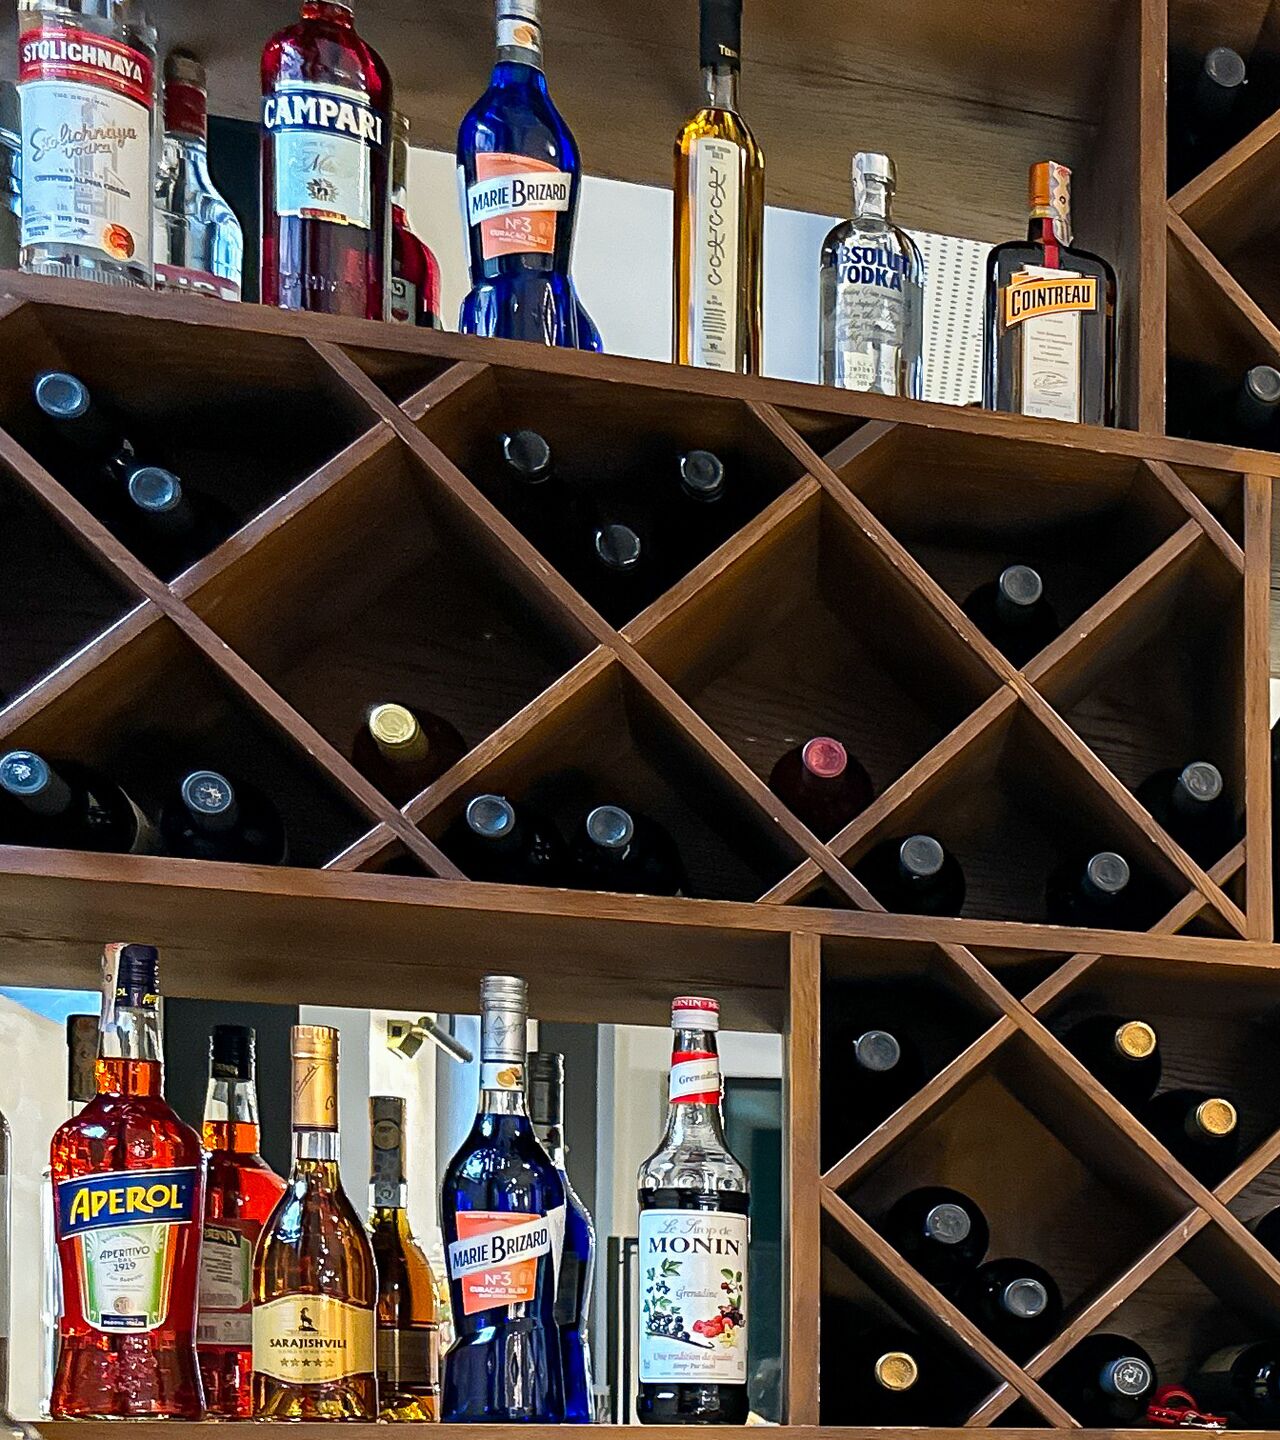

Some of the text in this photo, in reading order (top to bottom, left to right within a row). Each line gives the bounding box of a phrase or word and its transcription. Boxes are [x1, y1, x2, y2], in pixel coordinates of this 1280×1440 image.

[23, 40, 143, 83] STOLICHNAYA
[264, 95, 383, 145] CAMPARI
[472, 180, 566, 215] MARIE BRIZARD
[837, 265, 902, 292] VODKA
[1012, 286, 1091, 317] COINTREAU
[69, 1184, 183, 1225] APEROL
[99, 1245, 150, 1260] APERITIVO
[453, 1228, 547, 1270] MARIE BRIZARD
[649, 1236, 739, 1256] MONIN
[113, 1261, 136, 1272] 1919
[675, 1285, 718, 1299] Grenadine
[269, 1338, 346, 1349] SARAJISHVILI
